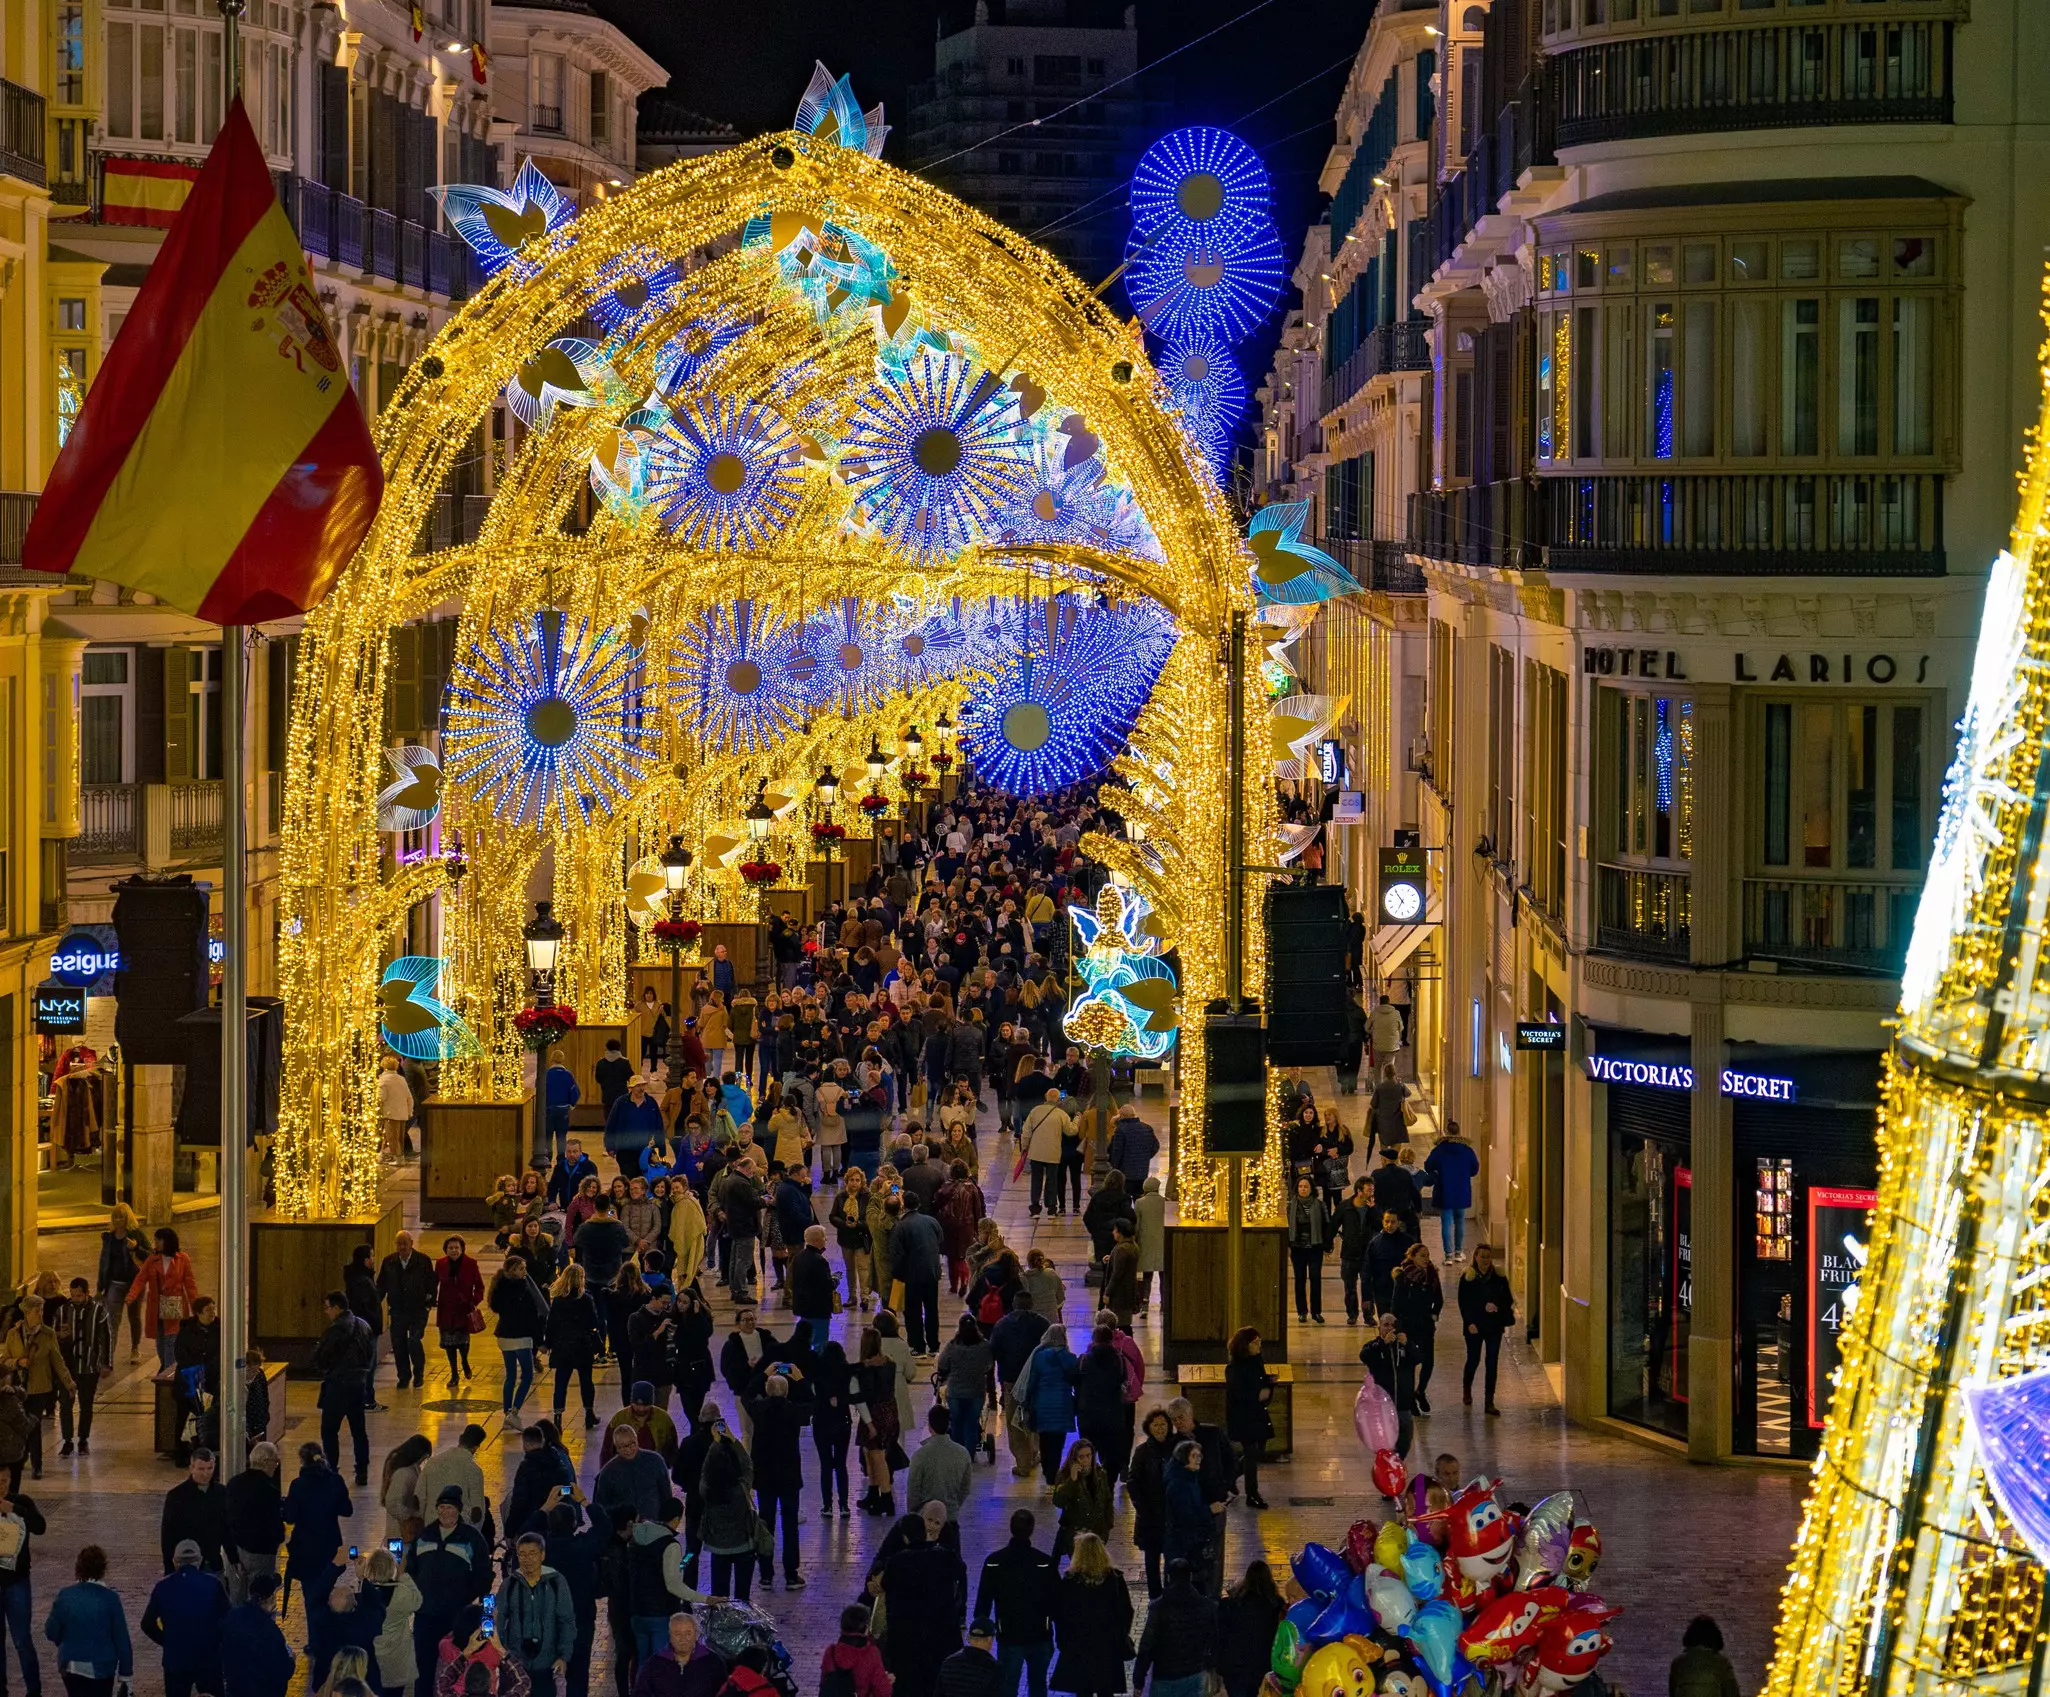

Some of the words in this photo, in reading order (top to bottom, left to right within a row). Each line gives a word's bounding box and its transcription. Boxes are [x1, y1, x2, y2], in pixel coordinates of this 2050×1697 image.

[1584, 647, 1686, 680] HOTEL
[1735, 653, 1931, 684] LARIOS
[1323, 742, 1332, 783] PRIMOR
[1342, 799, 1360, 807] COS
[1384, 865, 1420, 873] ROLEX
[40, 1000, 79, 1011] NYX
[1588, 1056, 1693, 1088] VICTORIA'S
[1722, 1070, 1793, 1099] SECRET
[1816, 1191, 1853, 1200] VICTORIA'S
